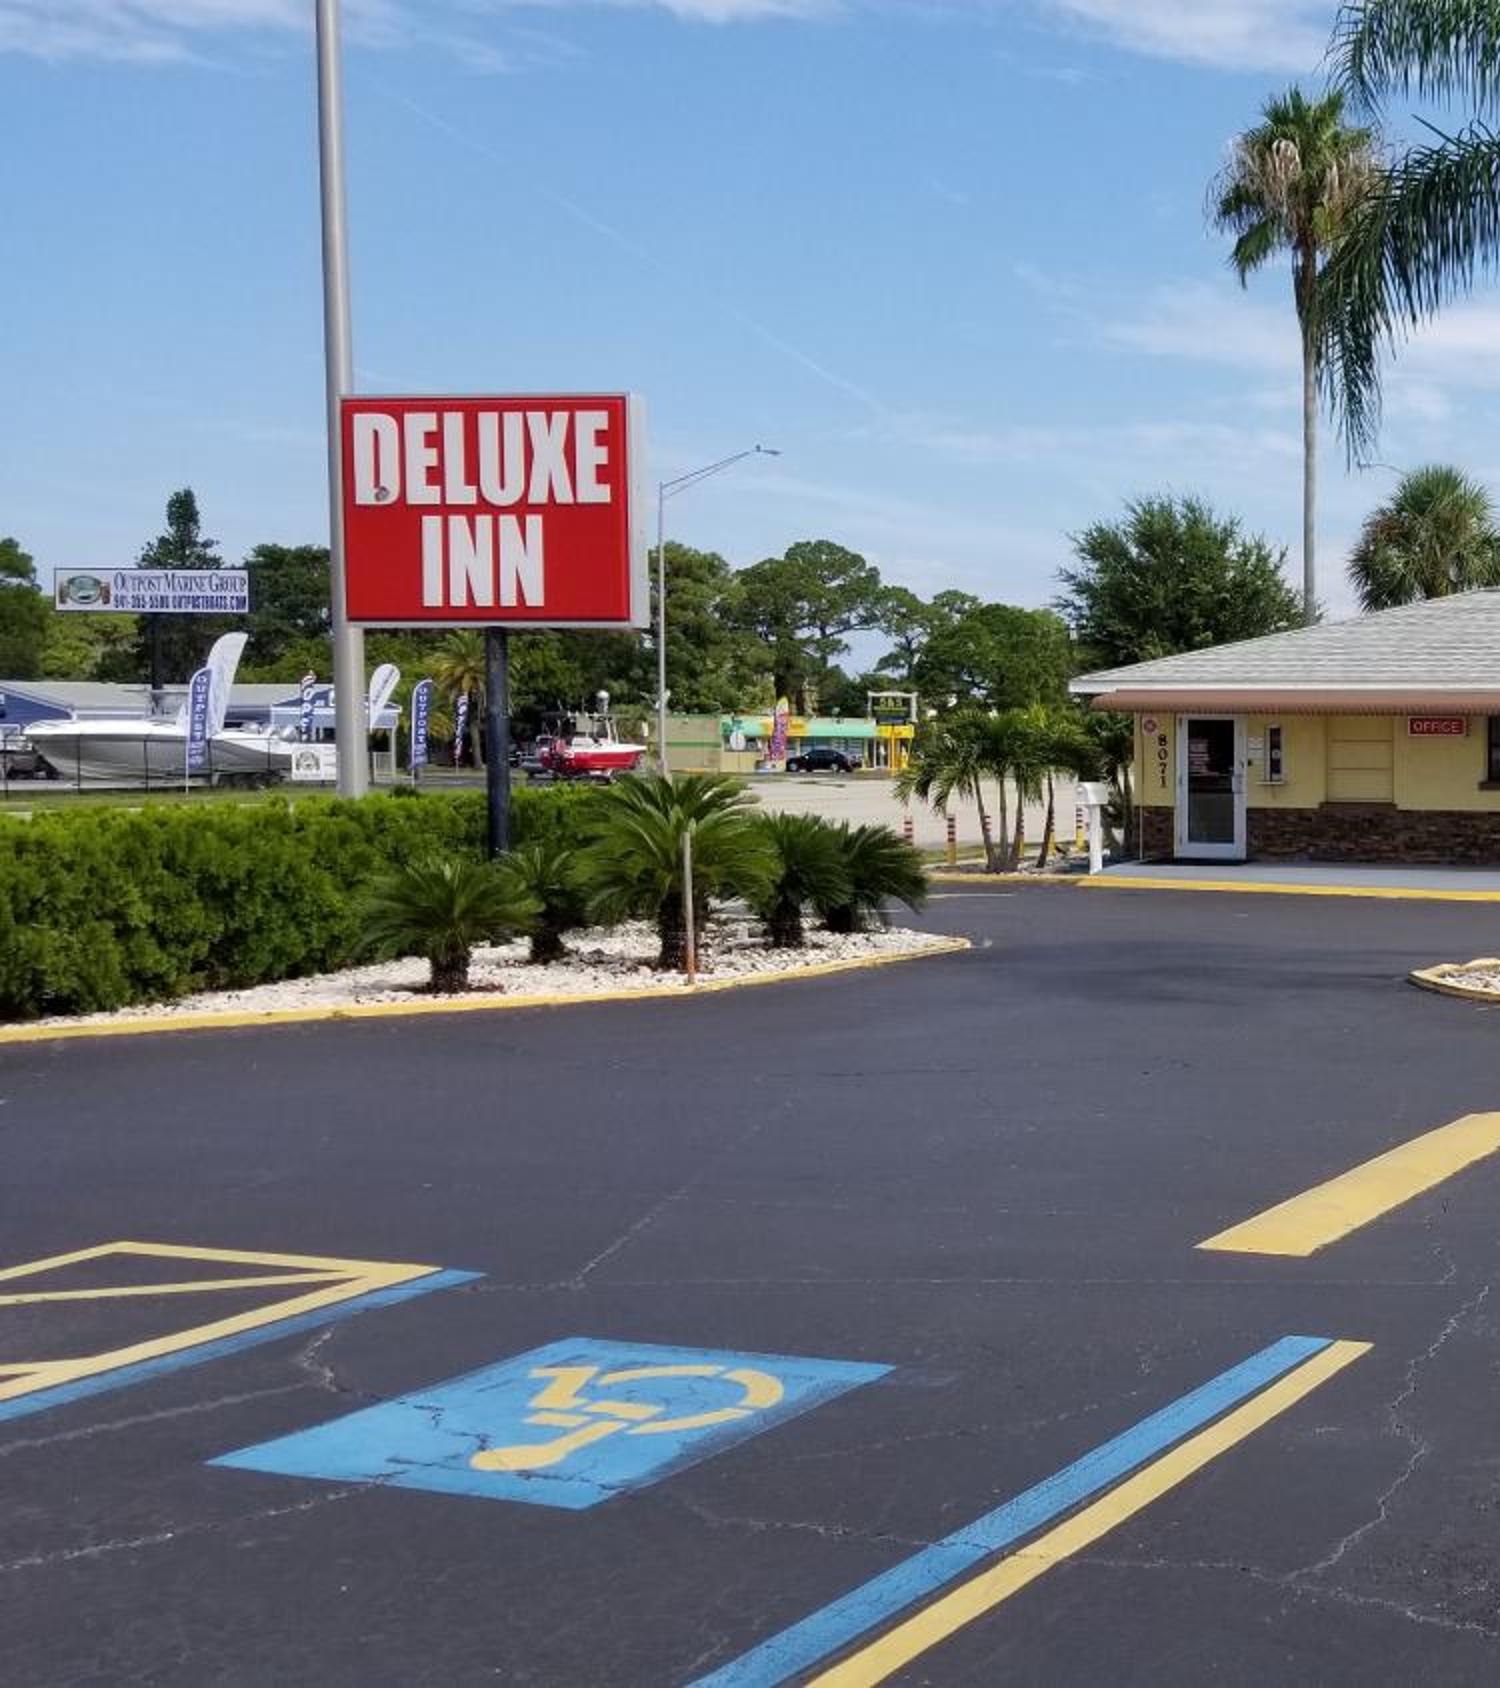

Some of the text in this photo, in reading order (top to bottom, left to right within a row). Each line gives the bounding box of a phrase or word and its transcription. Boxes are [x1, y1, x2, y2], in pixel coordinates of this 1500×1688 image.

[353, 410, 611, 506] DELUXE
[113, 572, 247, 592] OUTPOST MARINE GROUP
[421, 515, 545, 607] INN
[1413, 721, 1461, 733] OFFICE
[1157, 734, 1168, 788] 8071
